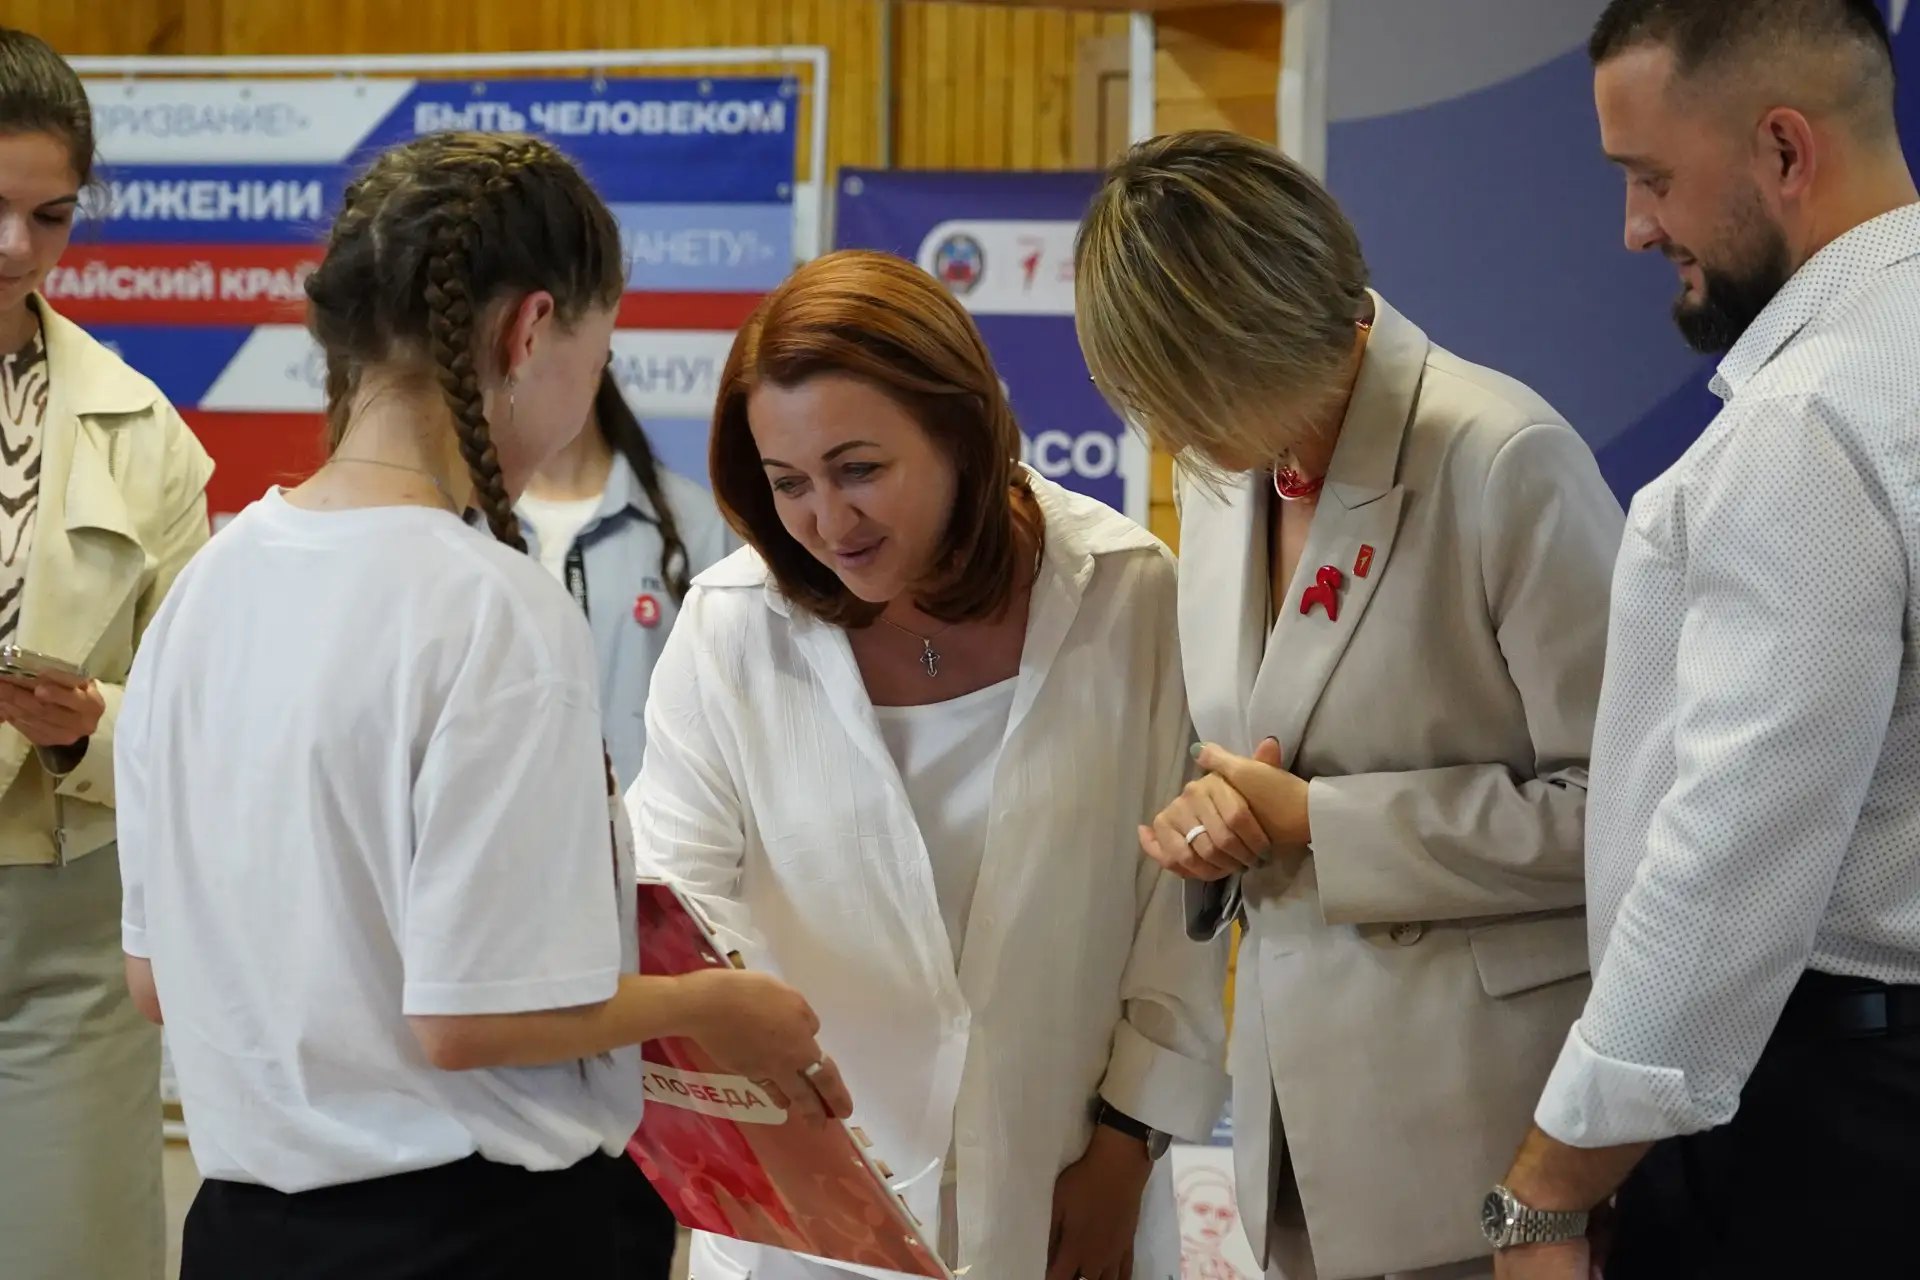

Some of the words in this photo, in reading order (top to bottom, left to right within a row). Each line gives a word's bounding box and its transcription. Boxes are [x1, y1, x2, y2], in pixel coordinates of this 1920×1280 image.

[414, 102, 526, 134] БЫТЬ
[530, 101, 787, 135] ЧЕЛОВЕКОМ
[650, 1073, 767, 1109] ПОБЕДА
